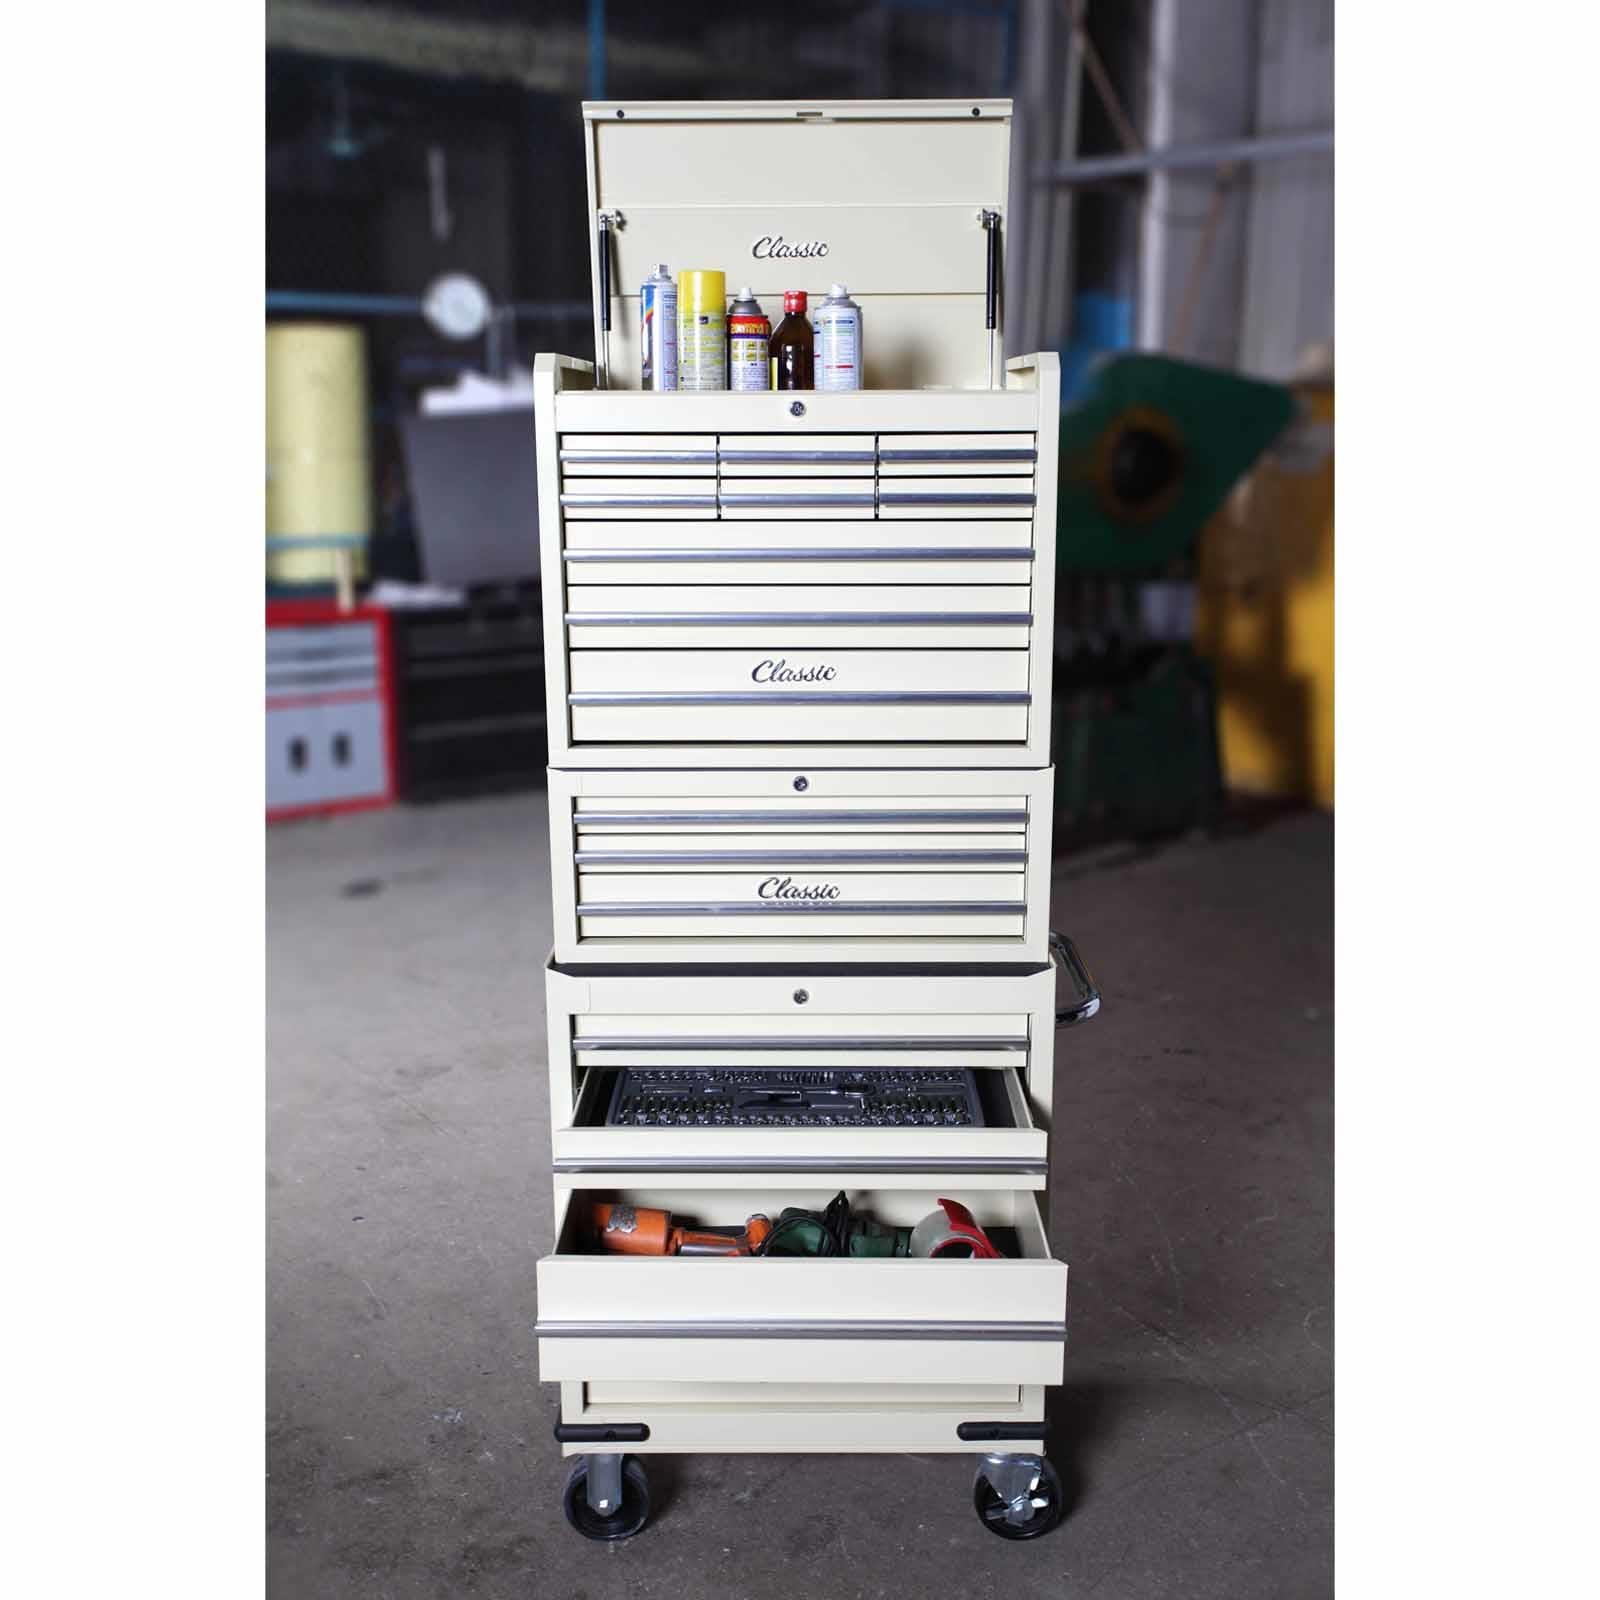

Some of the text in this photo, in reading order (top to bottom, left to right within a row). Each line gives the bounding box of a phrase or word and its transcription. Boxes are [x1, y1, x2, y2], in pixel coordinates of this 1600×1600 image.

[752, 236, 830, 259] Classic
[751, 659, 837, 683] Classic
[758, 877, 840, 899] Classic
